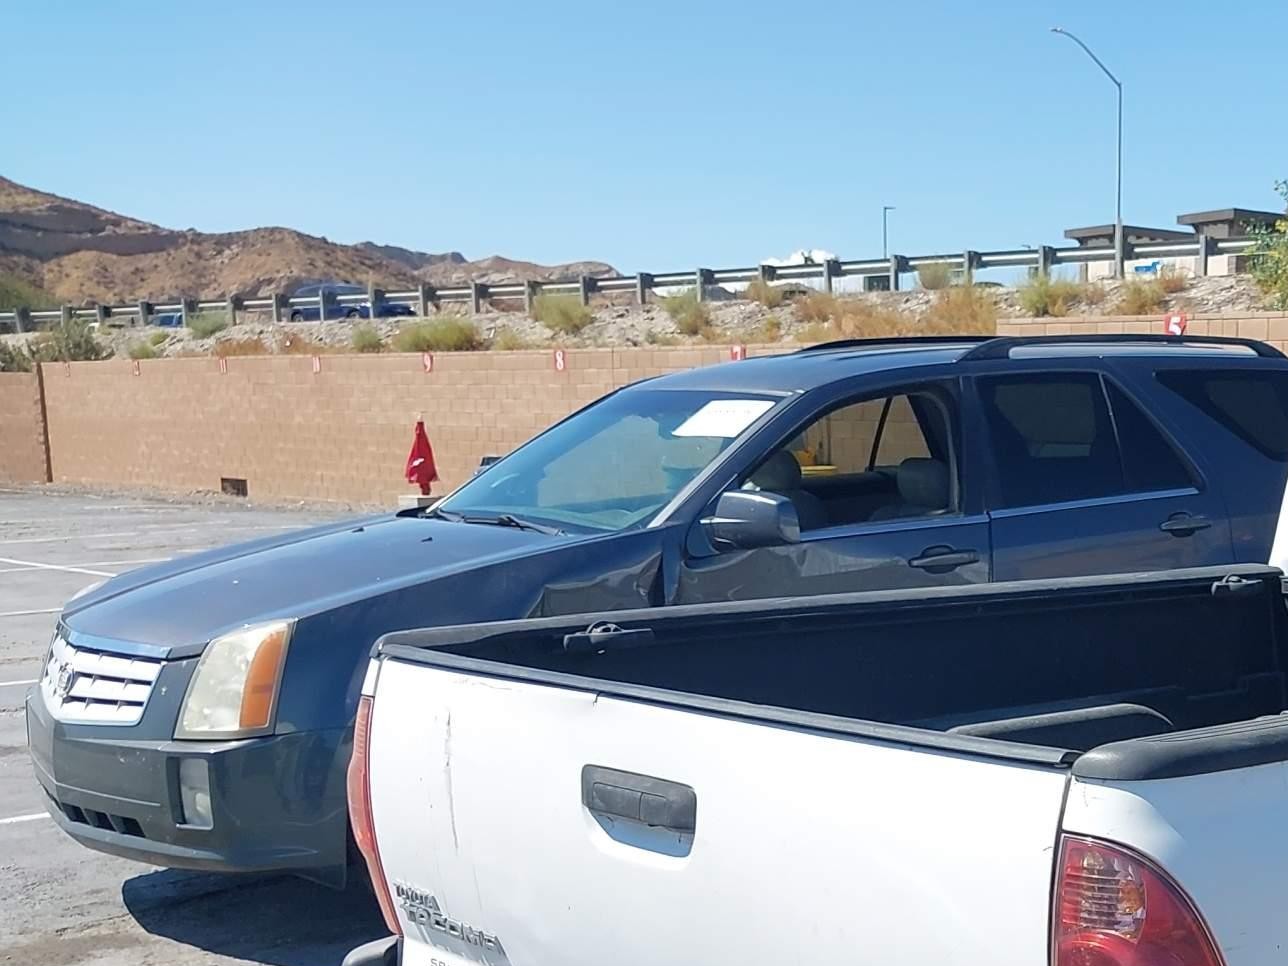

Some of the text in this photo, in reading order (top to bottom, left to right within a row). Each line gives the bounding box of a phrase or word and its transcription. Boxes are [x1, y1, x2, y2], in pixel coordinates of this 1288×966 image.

[1168, 315, 1182, 335] 5
[423, 352, 432, 372] 9
[555, 350, 564, 370] 8
